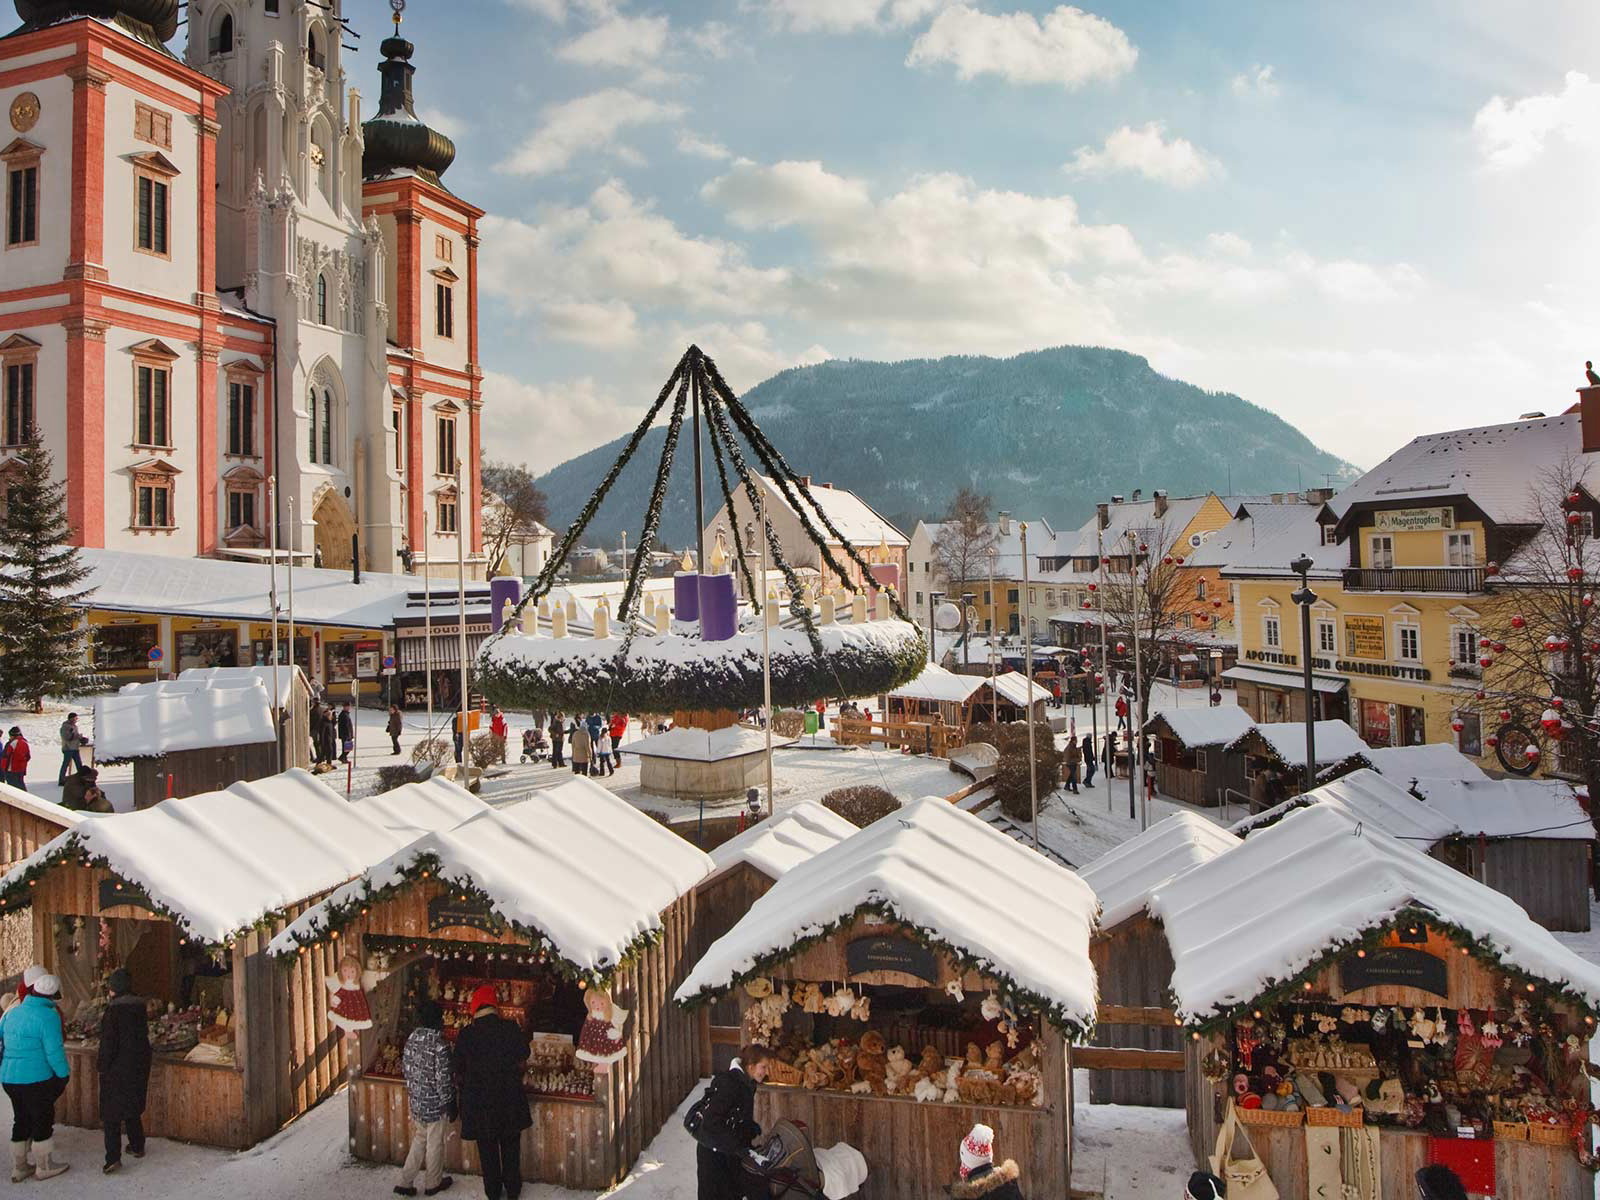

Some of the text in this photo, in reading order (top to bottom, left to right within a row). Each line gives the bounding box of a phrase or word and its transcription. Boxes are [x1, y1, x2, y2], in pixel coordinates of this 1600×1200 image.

[1391, 516, 1440, 527] Magentropfen
[424, 624, 491, 636] OUVNIR
[1246, 650, 1431, 680] APOTHEKE ZUR GNADENMUTTER
